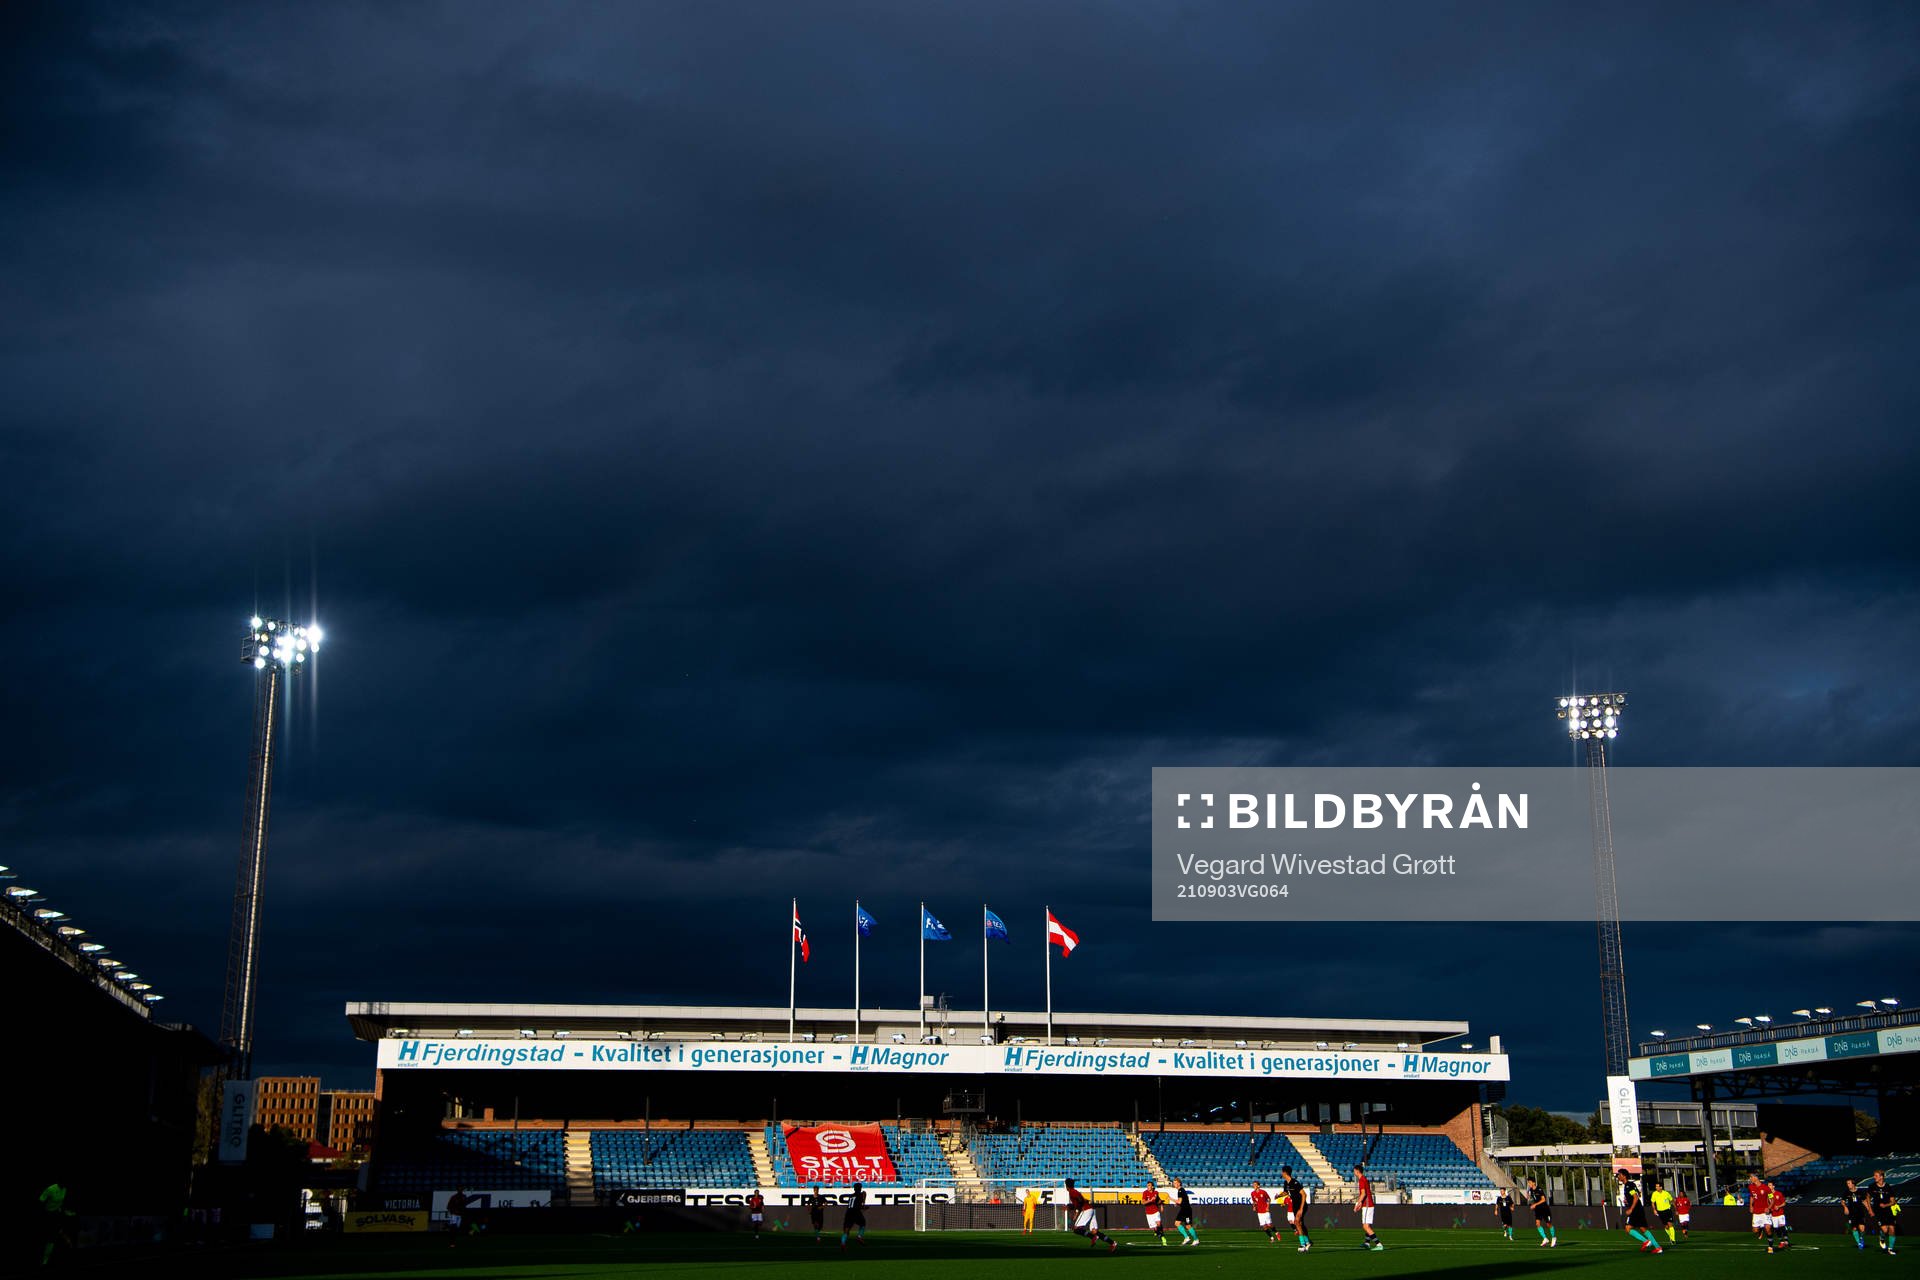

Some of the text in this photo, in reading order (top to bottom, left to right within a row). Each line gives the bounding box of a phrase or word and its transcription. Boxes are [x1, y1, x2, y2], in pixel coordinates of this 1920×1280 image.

[1834, 1040, 1849, 1054] DNB
[1887, 1033, 1902, 1048] DNB
[422, 1044, 565, 1066] Fjerdingstad
[592, 1045, 672, 1062] Kvalitet
[679, 1045, 684, 1063] i
[691, 1045, 824, 1068] generasjoner
[871, 1047, 949, 1069] Magnor
[1738, 1051, 1752, 1065] DNB
[1784, 1045, 1798, 1059] DNB
[1025, 1050, 1150, 1071] Fjerdingstad
[1174, 1052, 1244, 1070] Kvalitet
[1250, 1053, 1255, 1070] i
[1261, 1055, 1380, 1078] generasjoner
[1421, 1056, 1491, 1077] Magnor
[800, 1156, 883, 1168] SKILT
[808, 1168, 883, 1181] DESIGN
[384, 1199, 421, 1209] VICTORIA
[627, 1194, 681, 1204] GJERBERG
[356, 1215, 417, 1226] SOLVASK
